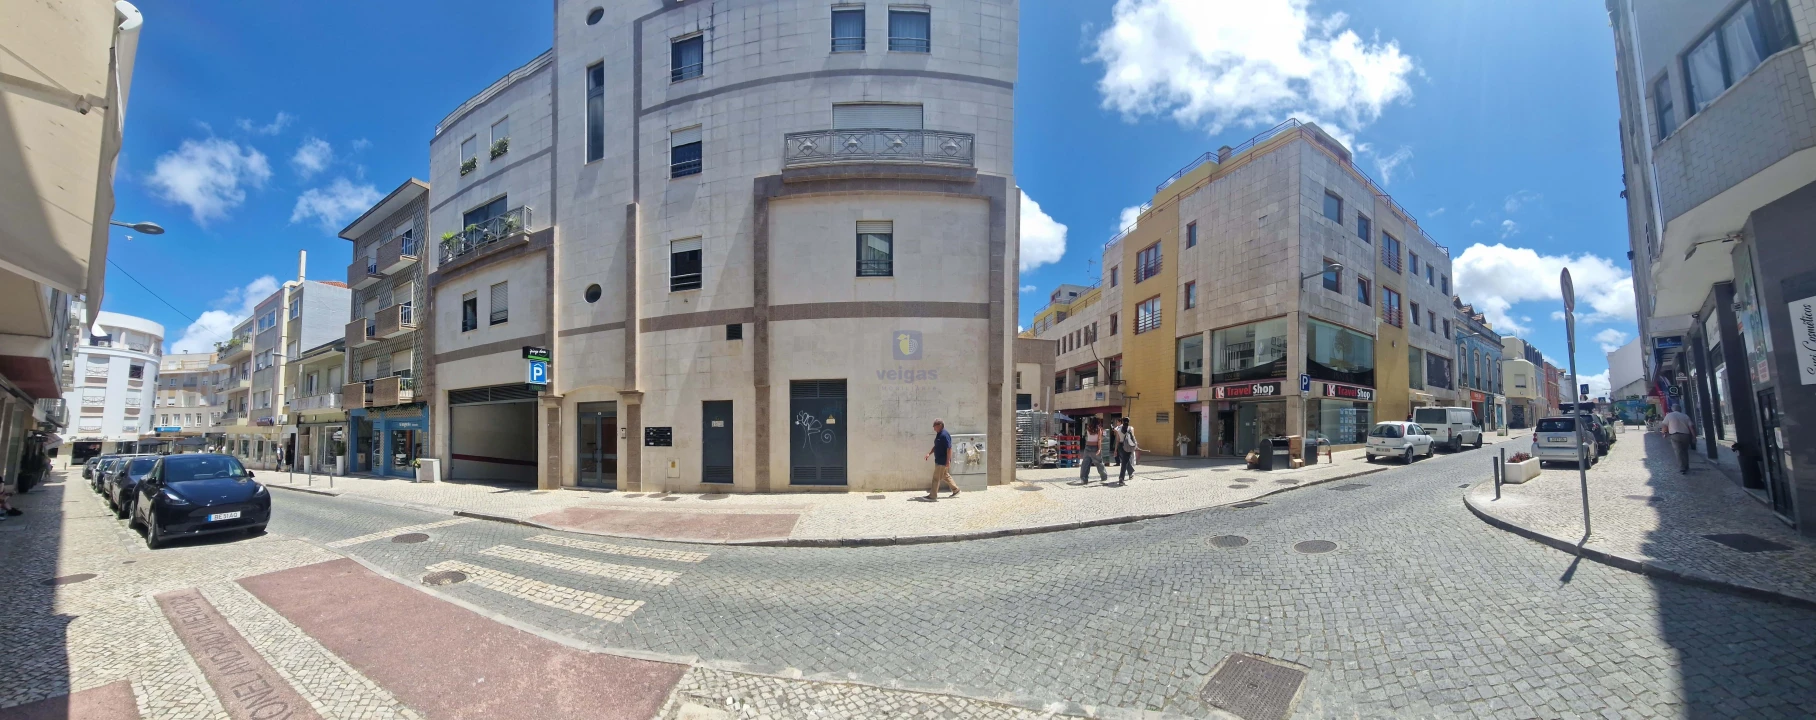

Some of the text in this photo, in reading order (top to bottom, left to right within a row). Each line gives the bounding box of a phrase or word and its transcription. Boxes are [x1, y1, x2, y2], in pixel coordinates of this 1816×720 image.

[534, 366, 543, 381] P
[1302, 376, 1308, 389] P
[231, 672, 293, 720] ONEL
